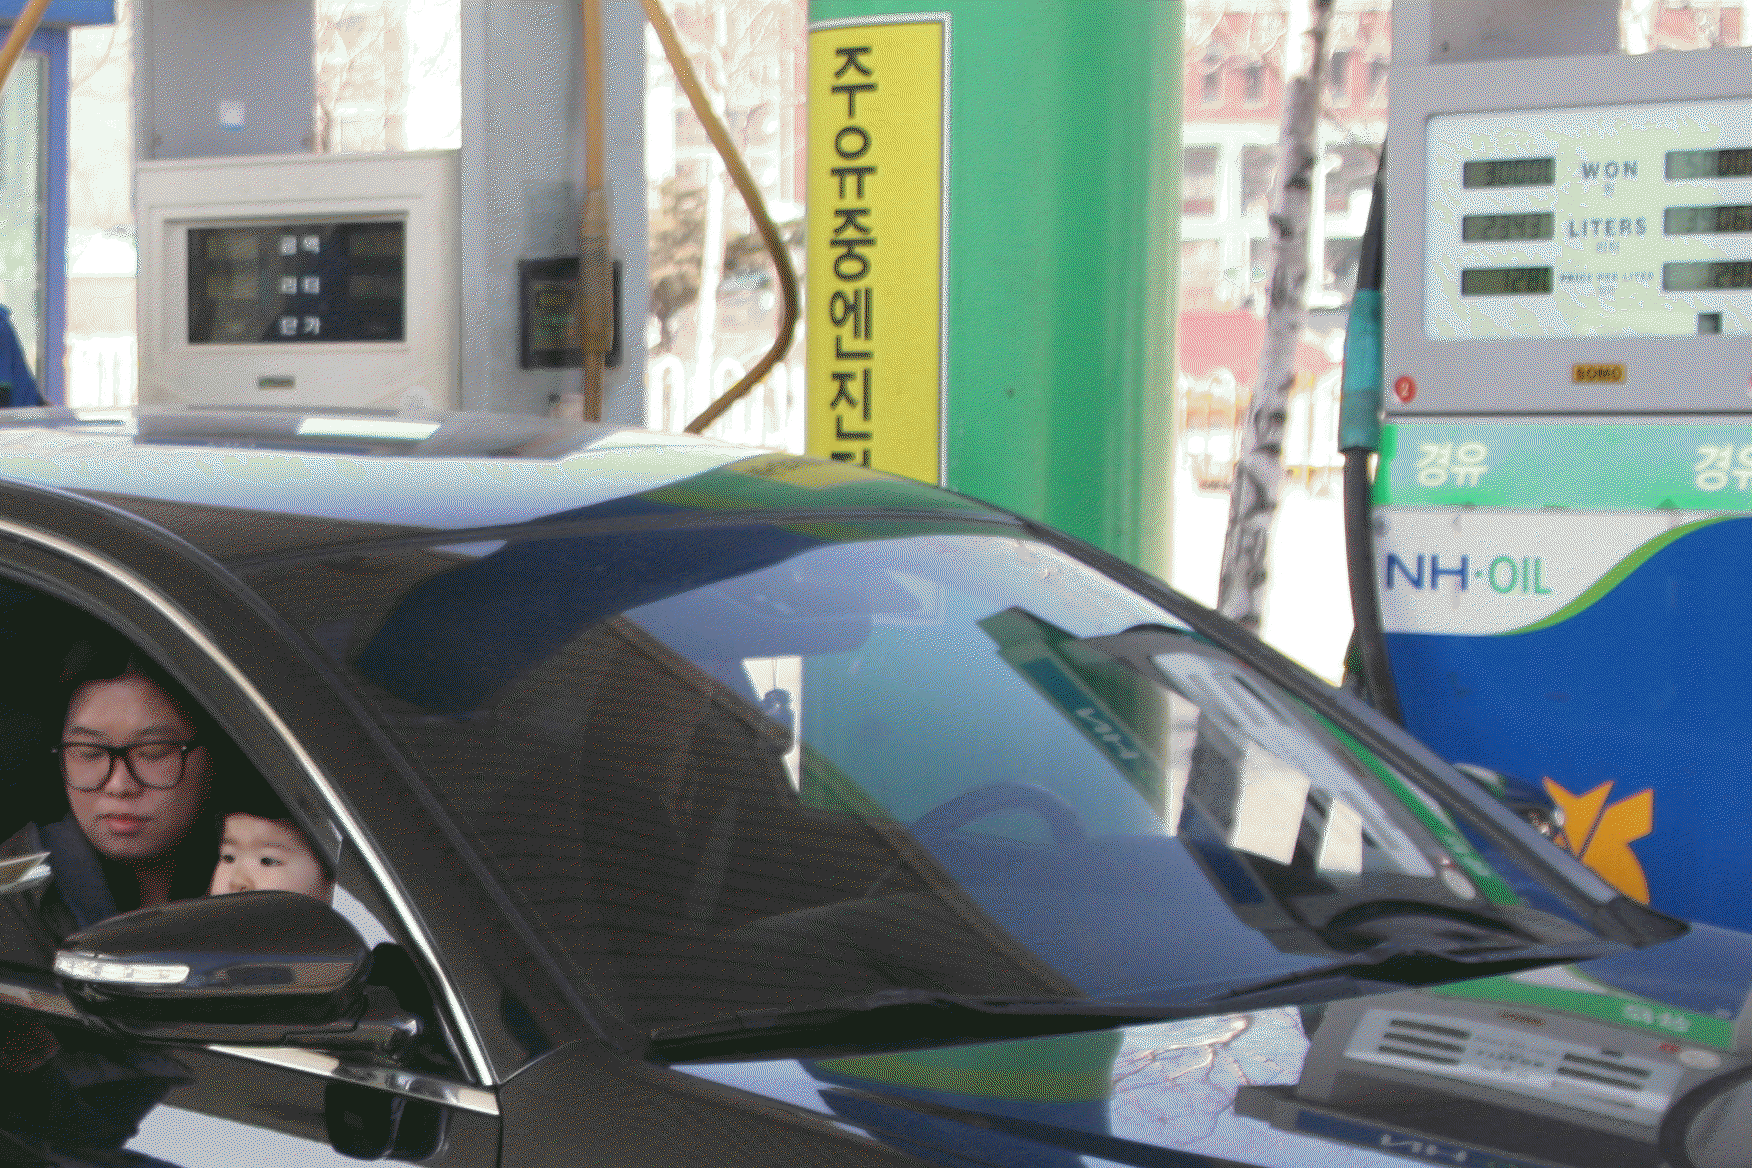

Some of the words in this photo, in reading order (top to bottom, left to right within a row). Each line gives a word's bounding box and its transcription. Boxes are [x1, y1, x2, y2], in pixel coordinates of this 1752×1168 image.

[1581, 160, 1639, 179] WON
[1568, 217, 1647, 239] LITERS
[1417, 441, 1488, 488] 경유
